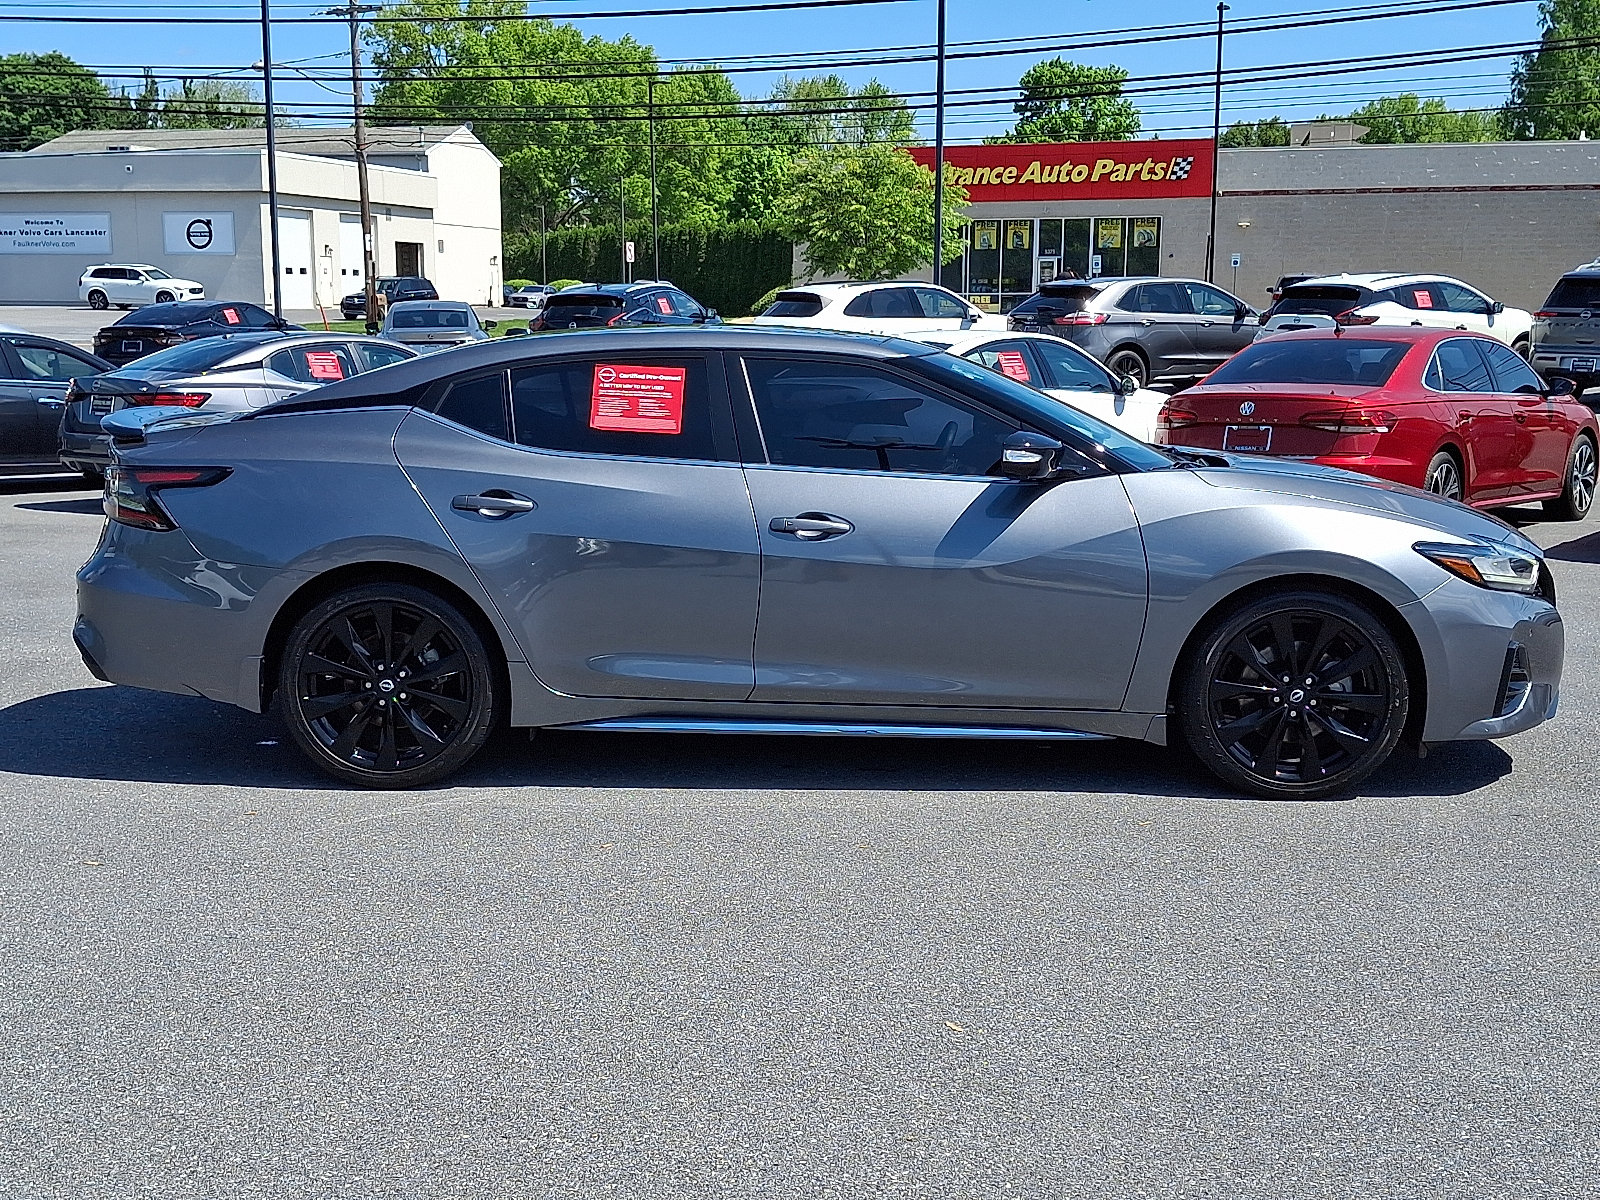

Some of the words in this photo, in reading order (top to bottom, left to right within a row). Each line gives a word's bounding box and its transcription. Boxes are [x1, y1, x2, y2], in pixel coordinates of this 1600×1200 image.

[1018, 159, 1089, 184] Auto
[1090, 157, 1167, 182] Parts
[13, 240, 76, 248] FaulknerVolvo.com
[969, 295, 991, 304] FREE
[618, 372, 646, 380] Certified
[646, 374, 682, 382] Pre-Owned
